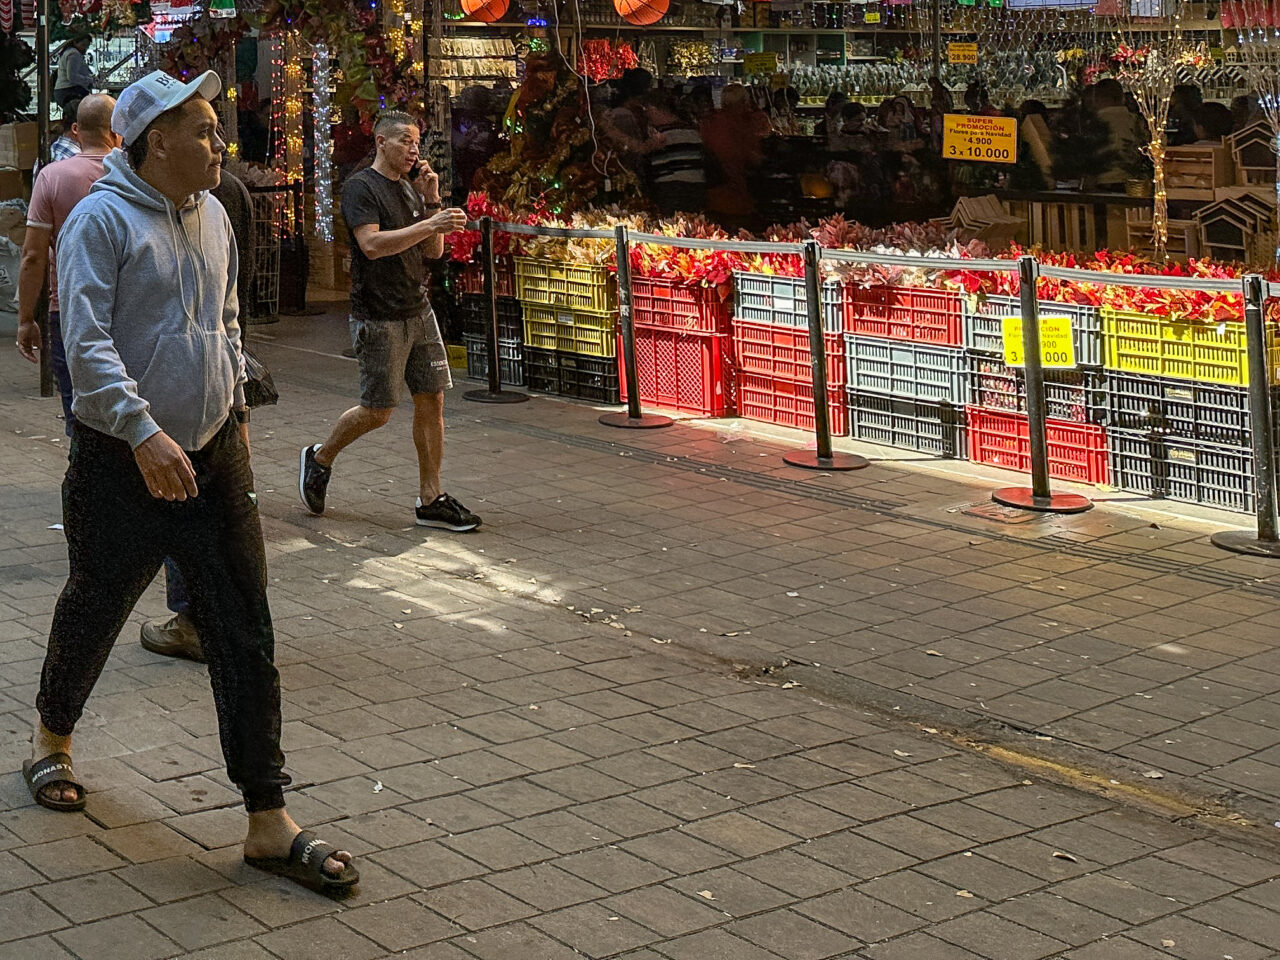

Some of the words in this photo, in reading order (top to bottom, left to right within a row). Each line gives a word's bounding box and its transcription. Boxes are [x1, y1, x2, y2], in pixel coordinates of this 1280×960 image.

[966, 117, 994, 125] SUPER
[956, 123, 1005, 132] PROMOCIÓN
[949, 145, 957, 155] 3
[968, 146, 1010, 159] 10.000
[1010, 351, 1018, 362] 3
